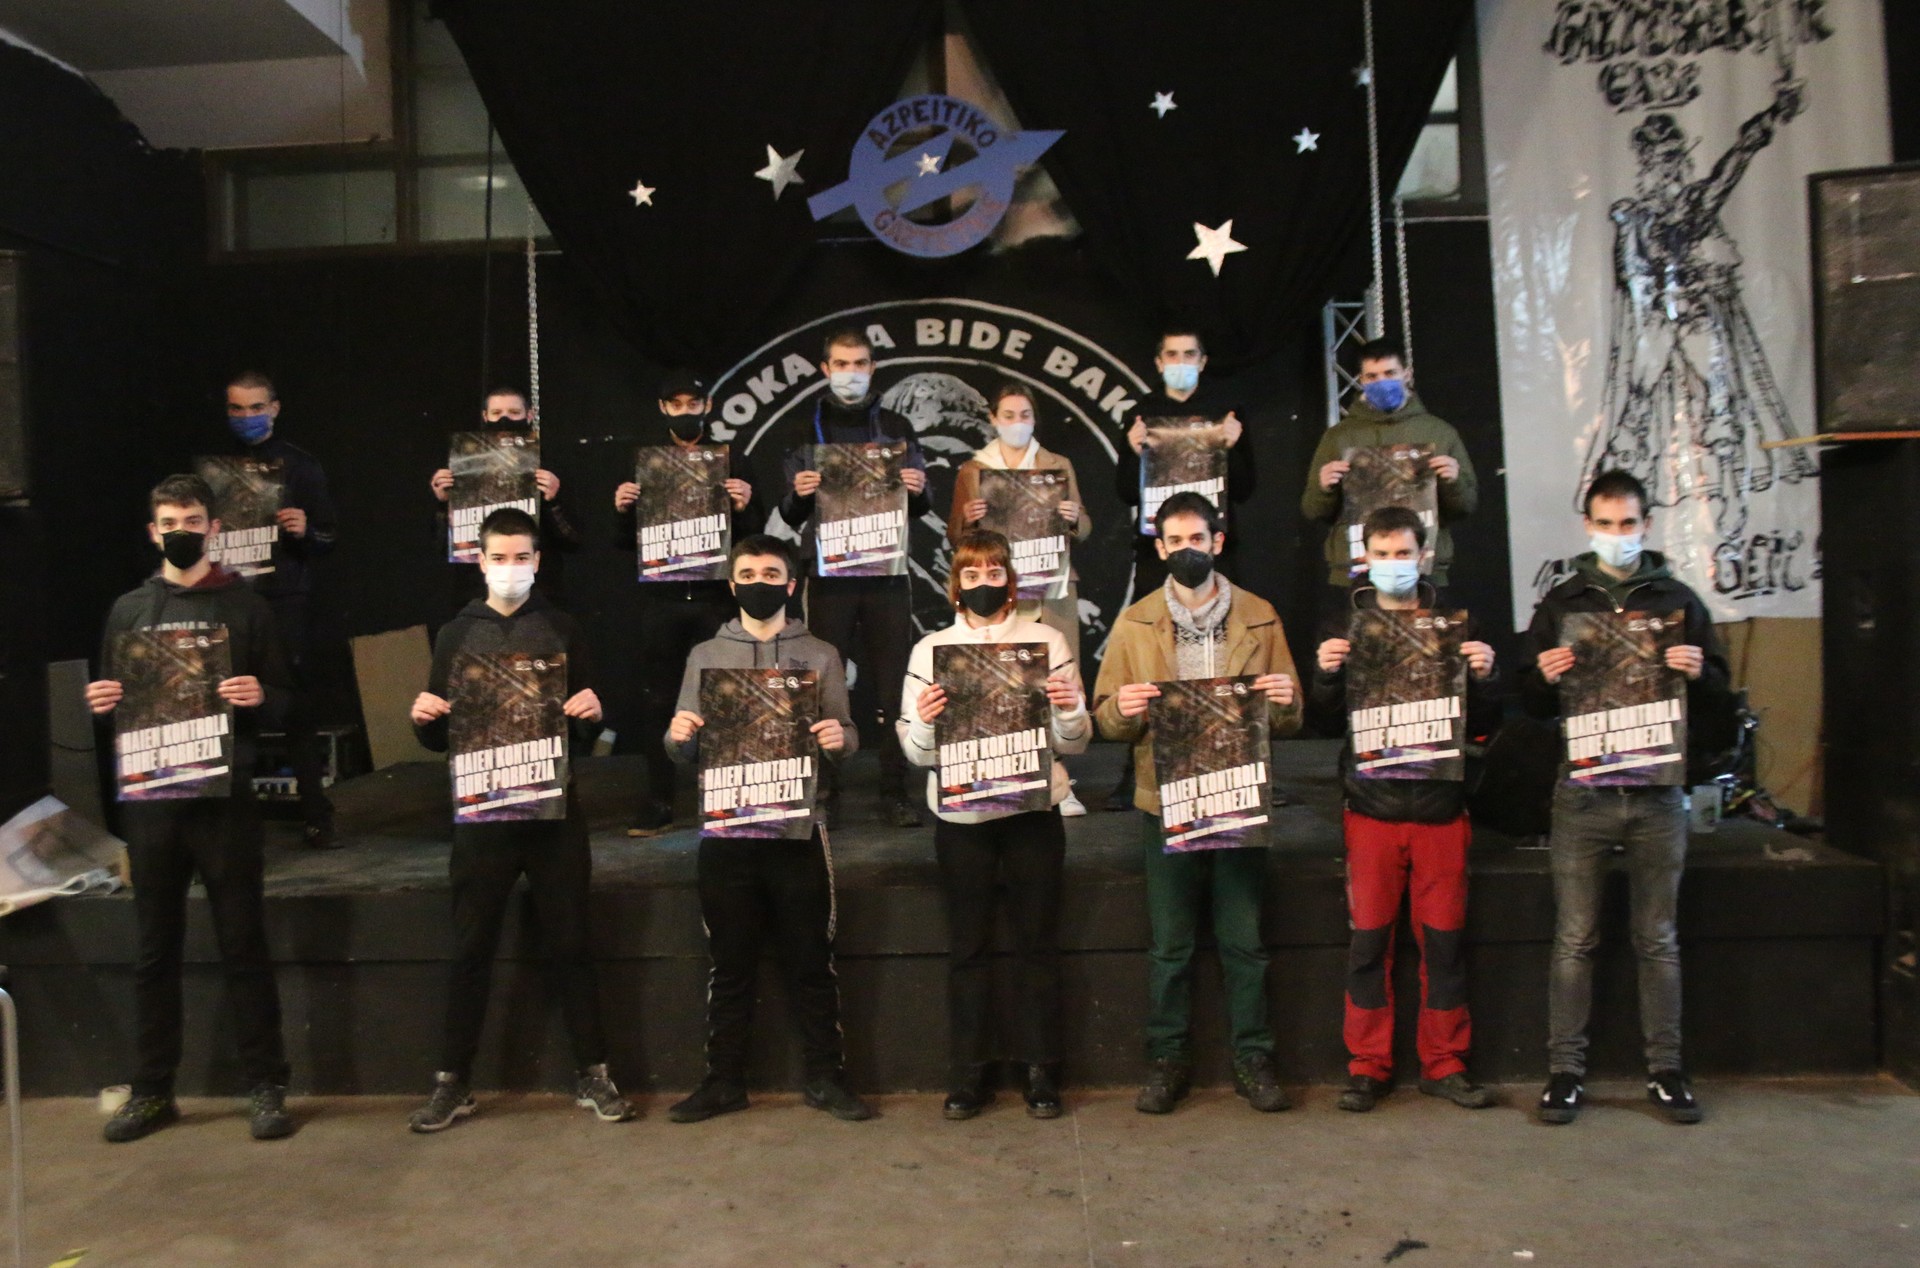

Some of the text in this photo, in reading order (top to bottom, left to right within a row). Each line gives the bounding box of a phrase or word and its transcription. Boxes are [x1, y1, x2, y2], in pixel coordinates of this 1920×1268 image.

[867, 98, 997, 149] AZPEITIKO
[866, 324, 896, 348] A
[916, 318, 1032, 360] BIDE
[1043, 346, 1137, 428] BAK
[641, 513, 727, 546] HAIEN KONTROLA
[820, 509, 905, 541] HAIEN KONTROLA
[821, 527, 898, 557] GURE POBREZIA
[642, 531, 721, 562] GURE POBREZIA
[122, 713, 229, 754] HAIEN KONTROLA
[940, 727, 1047, 766] HAIEN KONTROLA
[121, 736, 223, 776] GURE POBREZIA
[455, 735, 563, 777] HAIEN KONTROLA
[704, 755, 812, 791] HAIEN KONTROLA
[940, 750, 1040, 788] GURE POBREZIA
[456, 759, 556, 799] GURE POBREZIA
[704, 778, 804, 813] GURE POBREZIA
[1160, 761, 1267, 807] HAIEN KONTROLA
[1163, 785, 1261, 829] GURE POBREZIA
